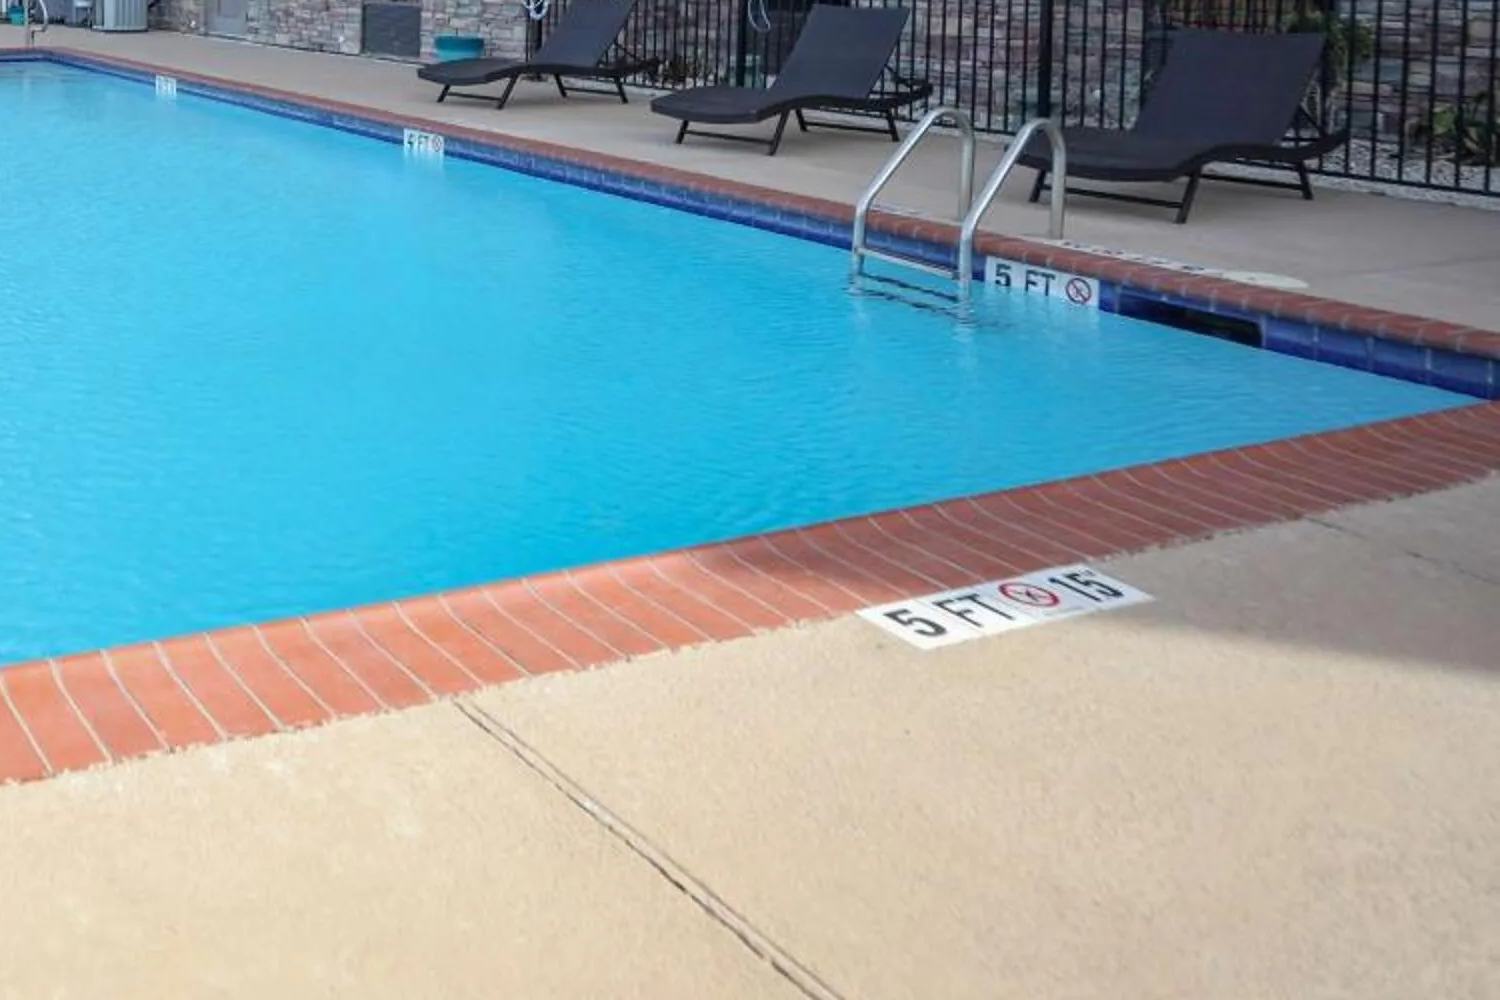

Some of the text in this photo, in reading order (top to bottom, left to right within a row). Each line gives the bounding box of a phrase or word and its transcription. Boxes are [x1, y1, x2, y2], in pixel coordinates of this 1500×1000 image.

[995, 263, 1056, 296] 5 FT
[883, 608, 947, 638] 5
[932, 592, 1016, 628] FT
